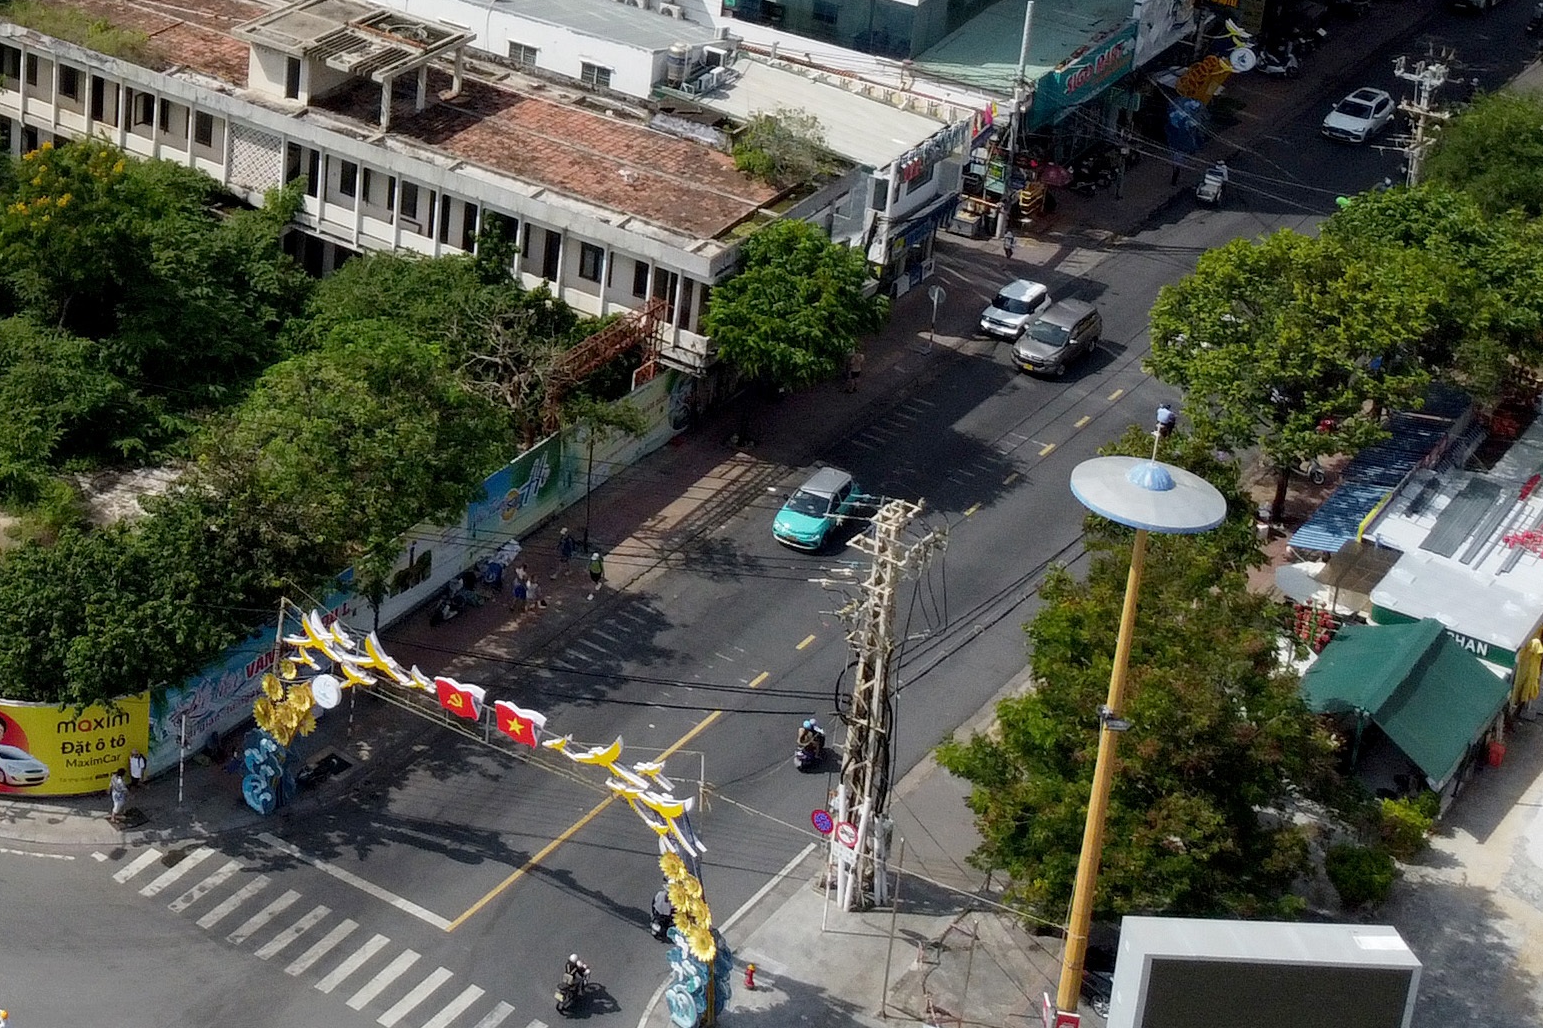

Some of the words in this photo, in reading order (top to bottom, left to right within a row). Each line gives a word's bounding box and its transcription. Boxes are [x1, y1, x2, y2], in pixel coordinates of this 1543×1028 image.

[57, 711, 130, 734] maxim
[61, 740, 92, 756] Đặt
[95, 736, 106, 751] ô
[110, 734, 126, 748] tô
[65, 754, 122, 768] MaximCar
